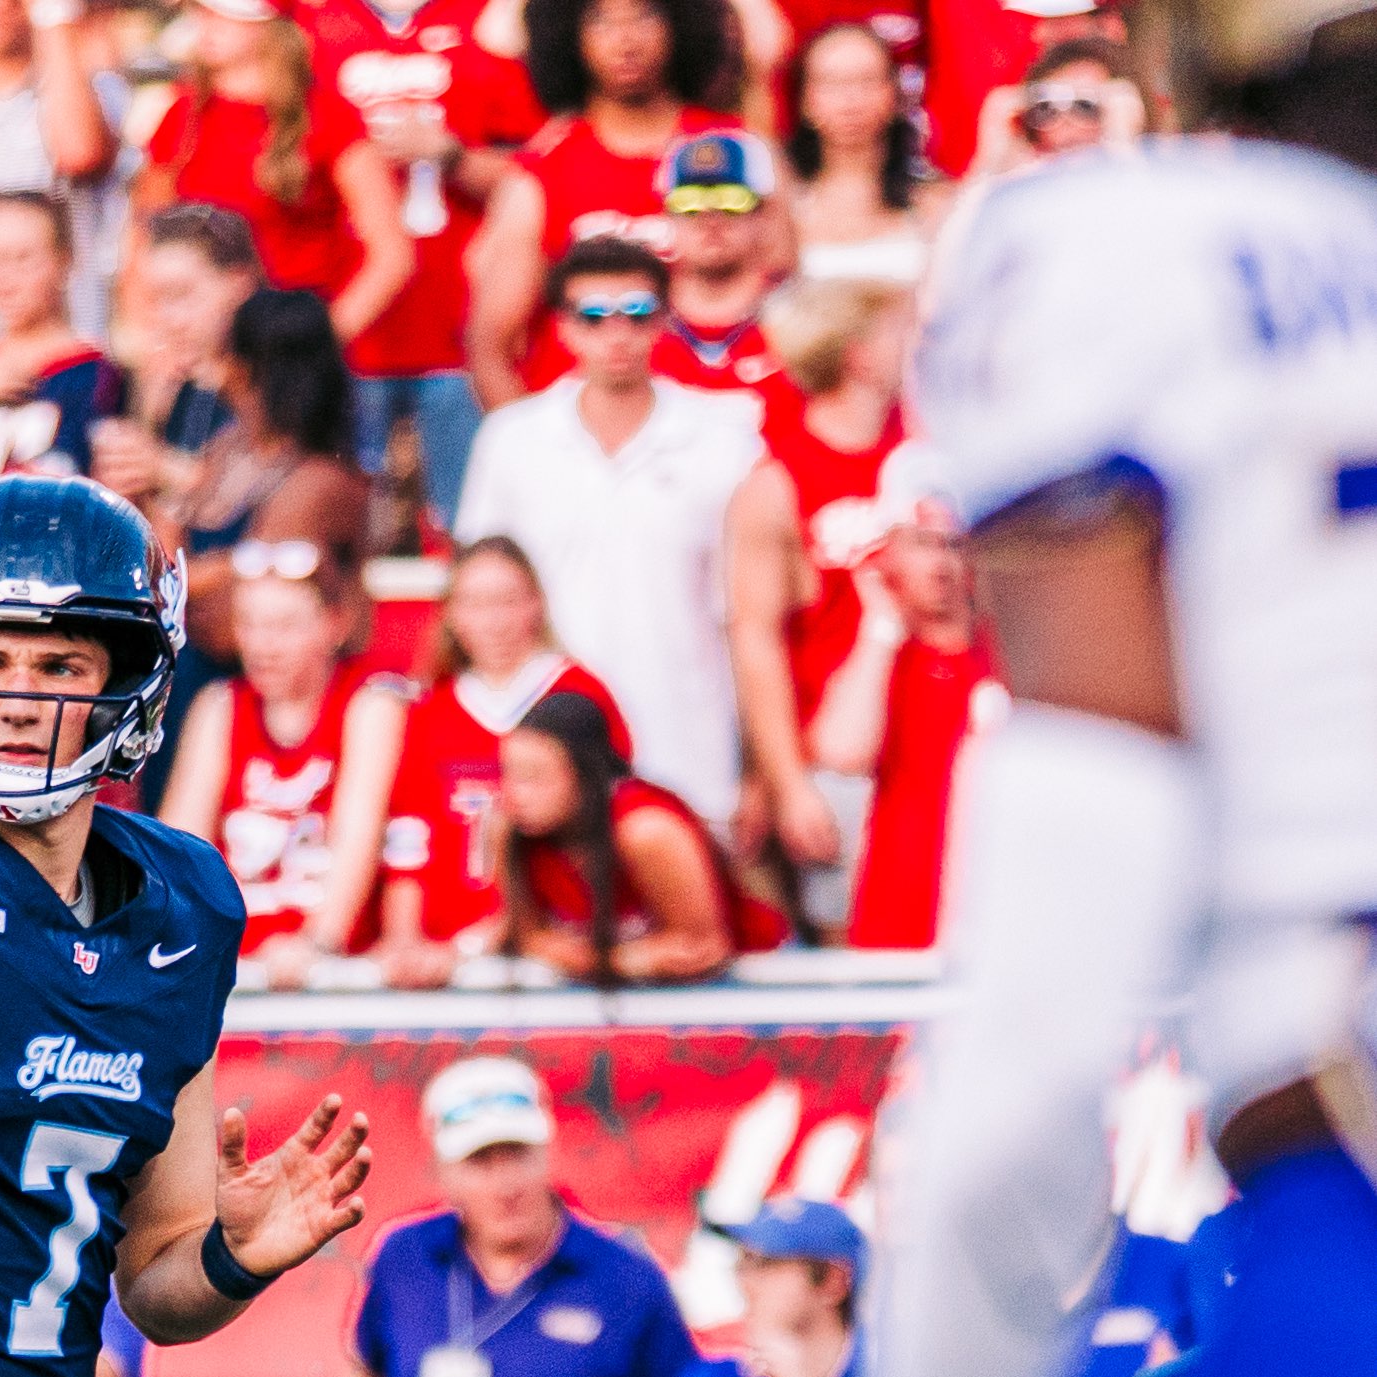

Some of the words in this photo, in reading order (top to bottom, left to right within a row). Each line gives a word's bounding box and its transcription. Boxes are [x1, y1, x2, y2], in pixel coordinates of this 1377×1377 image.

[73, 940, 100, 975] LU
[17, 1034, 144, 1102] Flames
[7, 1119, 130, 1358] 7
